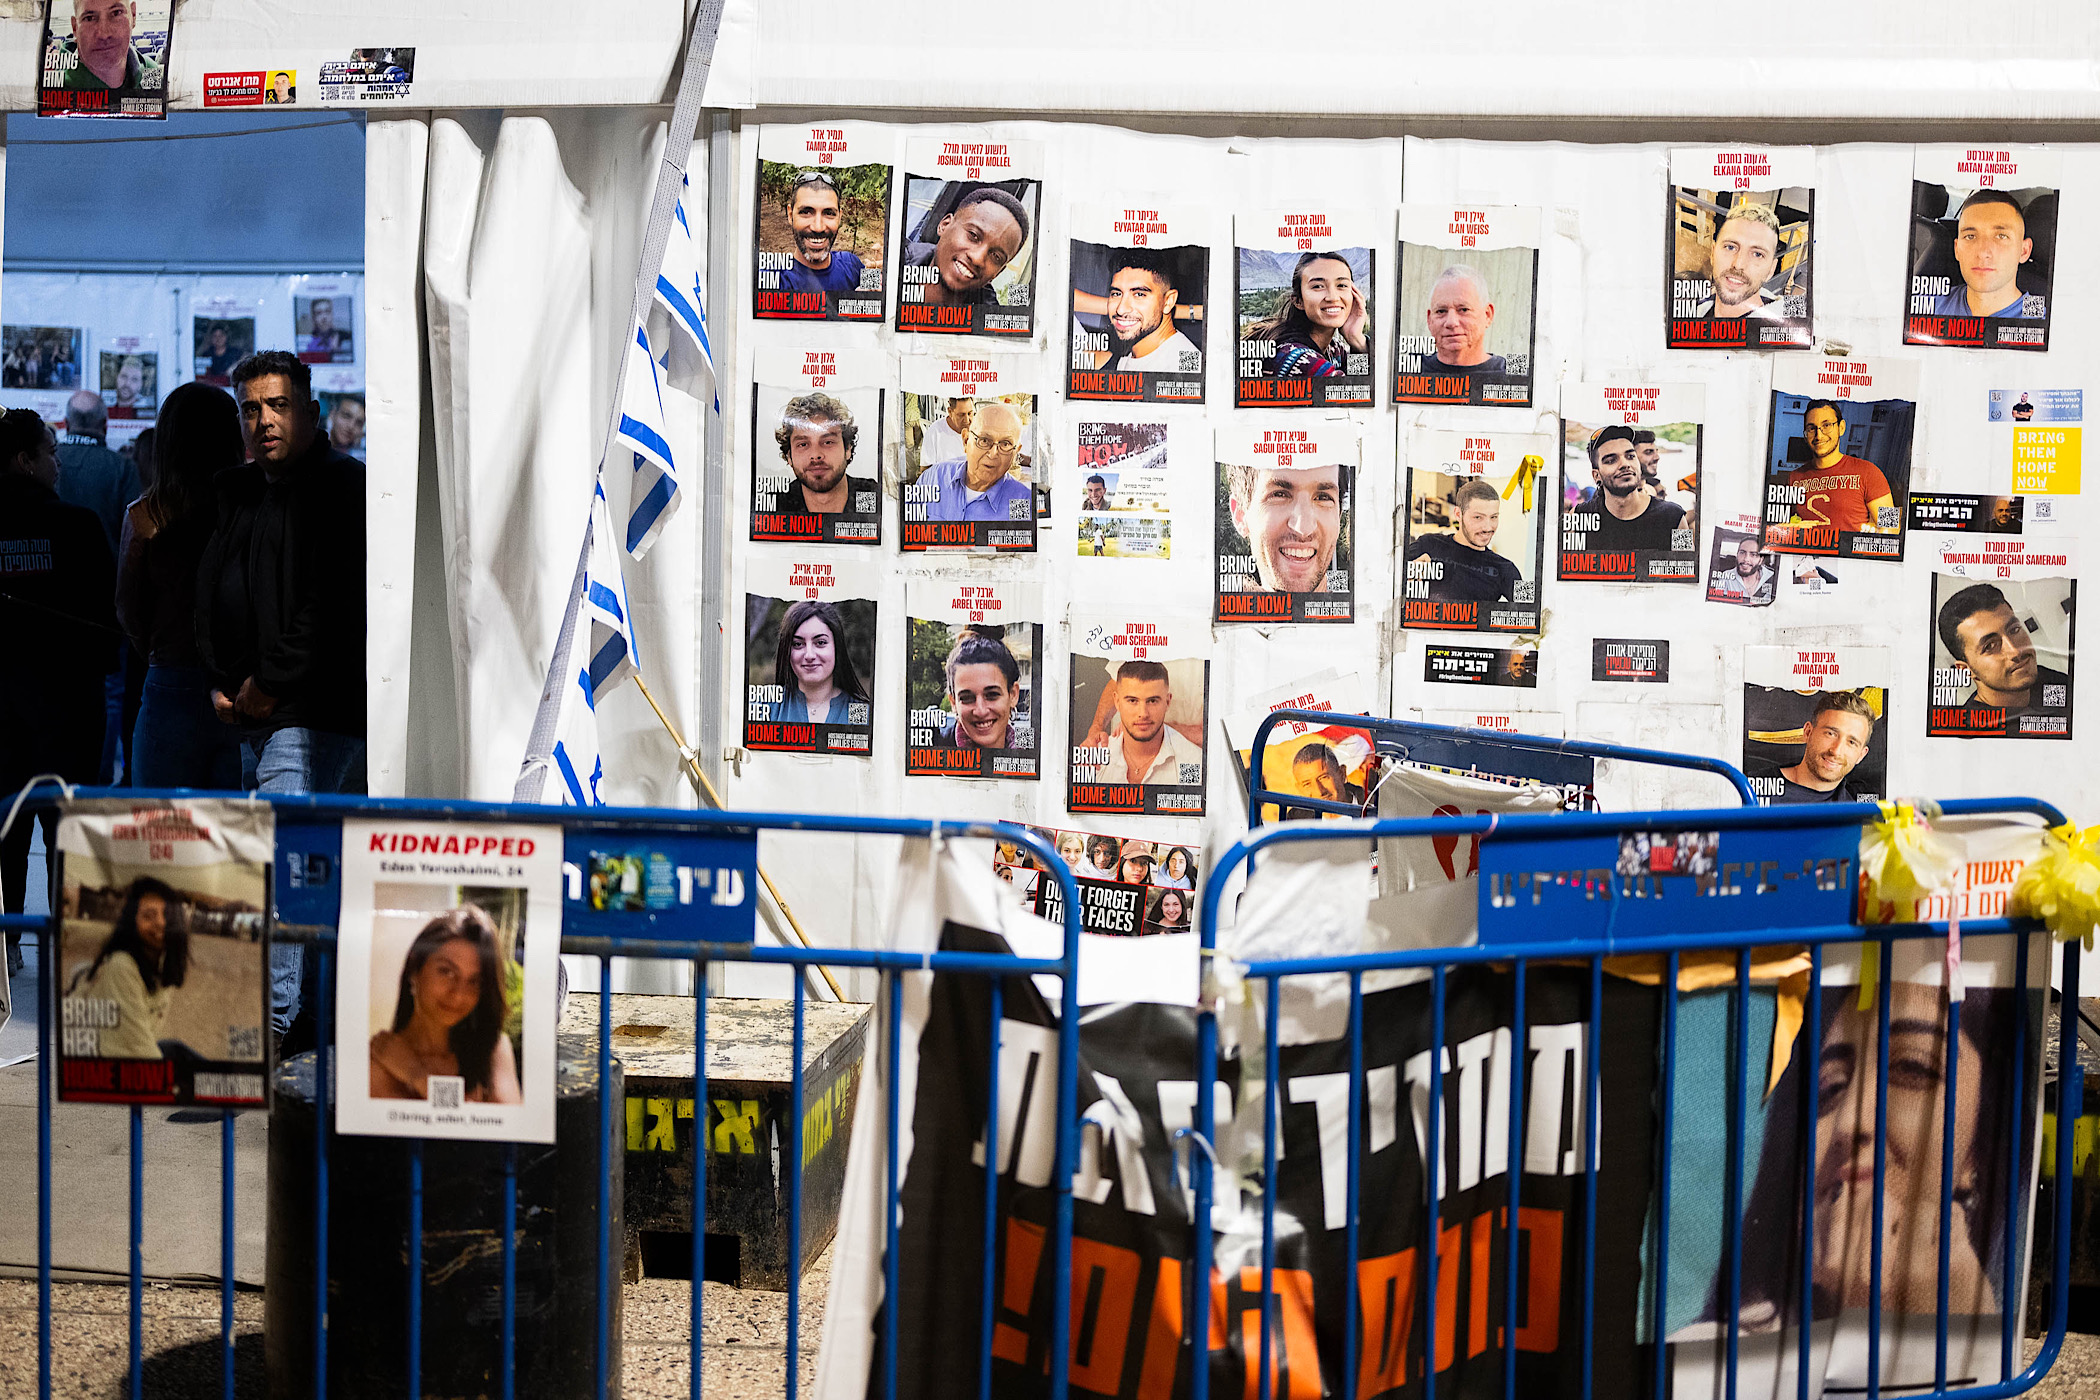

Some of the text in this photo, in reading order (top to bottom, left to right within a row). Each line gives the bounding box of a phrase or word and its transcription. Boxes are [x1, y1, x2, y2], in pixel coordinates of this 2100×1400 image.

[44, 53, 78, 69] BRING
[43, 70, 64, 88] HIM
[208, 76, 259, 87] מתן אנגרסט
[43, 90, 108, 109] HOME NOW!
[812, 129, 843, 140] תמיר אדר
[806, 141, 847, 151] TAMIR ADAR
[819, 153, 832, 164] (38)
[937, 155, 1010, 167] JOSHUA LOITU MOLLEL
[1967, 150, 2009, 162] מתן אנגרסט
[967, 167, 979, 179] (21)
[1714, 165, 1771, 176] ELKANA BOHBOT
[1958, 162, 2017, 174] MATAN ANGREST
[1735, 177, 1749, 188] (34)
[1980, 175, 1993, 187] (21)
[1124, 210, 1158, 221] אביתר דוד
[1285, 215, 1325, 225] נועה ארגמני
[1455, 211, 1484, 223] אילן וייס
[1115, 222, 1167, 233] EVYATAR DAVID
[1278, 226, 1331, 237] NOA ARGAMANI
[1449, 223, 1489, 234] ILAN WEISS
[1133, 234, 1147, 246] (23)
[1298, 238, 1312, 250] (26)
[1462, 236, 1475, 247] (56)
[759, 252, 793, 270] BRING
[758, 271, 780, 290] HIM
[1912, 276, 1950, 296] BRING
[758, 291, 826, 312] HOME NOW!
[1910, 296, 1934, 315] HIM
[1909, 317, 1984, 338] HOME NOW!
[1240, 340, 1276, 358] BRING
[806, 352, 834, 364] אלון אהל
[802, 365, 836, 375] ALON OHEL
[1240, 359, 1263, 378] HER
[1825, 361, 1867, 374] תמיר נמרודי
[812, 376, 825, 387] (22)
[941, 372, 997, 382] AMIRAM COOPER
[1818, 373, 1872, 386] TAMIR NIMRODI
[962, 384, 976, 395] (85)
[1240, 379, 1312, 398] HOME NOW!
[1604, 388, 1660, 399] יוסף חיים אוחנה
[1837, 386, 1850, 398] (19)
[1608, 400, 1655, 411] YOSEF OHANA
[1624, 412, 1639, 423] (24)
[1080, 424, 1106, 435] BRING
[1080, 436, 1122, 444] THEM HOME
[1264, 431, 1307, 442] שגיא דקל חן
[2018, 432, 2065, 444] BRING
[1254, 443, 1317, 453] SAGUI DEKEL CHEN
[2018, 447, 2056, 458] THEM
[1078, 443, 1128, 467] NOW
[1278, 455, 1292, 466] (35)
[1460, 450, 1494, 461] ITAY CHEN
[2018, 462, 2056, 474] HOME
[2017, 476, 2048, 488] NOW
[1916, 506, 1972, 520] הביתה
[1985, 542, 2024, 553] יונתן סמרנו
[1220, 555, 1256, 573] BRING
[1943, 553, 2066, 565] YONATHAN MORDECHAI SAMERANO
[1997, 566, 2010, 578] (21)
[790, 576, 835, 586] KARINA ARIEV
[1220, 574, 1243, 592] HIM
[806, 587, 818, 599] (19)
[960, 587, 993, 598] ארבל יהוד
[952, 599, 1001, 610] ARBEL YEHOUD
[1220, 594, 1292, 614] HOME NOW!
[970, 611, 983, 622] (28)
[1126, 624, 1155, 635] רון שרמן
[1113, 635, 1167, 646] RON SCHERMAN
[1134, 647, 1146, 658] (19)
[1607, 644, 1656, 657] מחזירים אותם
[1798, 652, 1835, 663] אבינתן אור
[1632, 658, 1656, 670] הביתה
[1793, 664, 1839, 675] AVINATAN OR
[1809, 676, 1823, 687] (30)
[1934, 668, 1971, 688] BRING
[1933, 688, 1957, 706] HIM
[1495, 717, 1509, 727] ירדן
[1932, 708, 2006, 728] HOME NOW!
[1292, 721, 1308, 735] (53)
[370, 833, 536, 858] KIDNAPPED
[380, 862, 414, 874] Eden
[1088, 884, 1138, 911] FORGET
[1088, 905, 1134, 931] FACES
[62, 999, 120, 1027] BRING
[63, 1028, 100, 1057] HER
